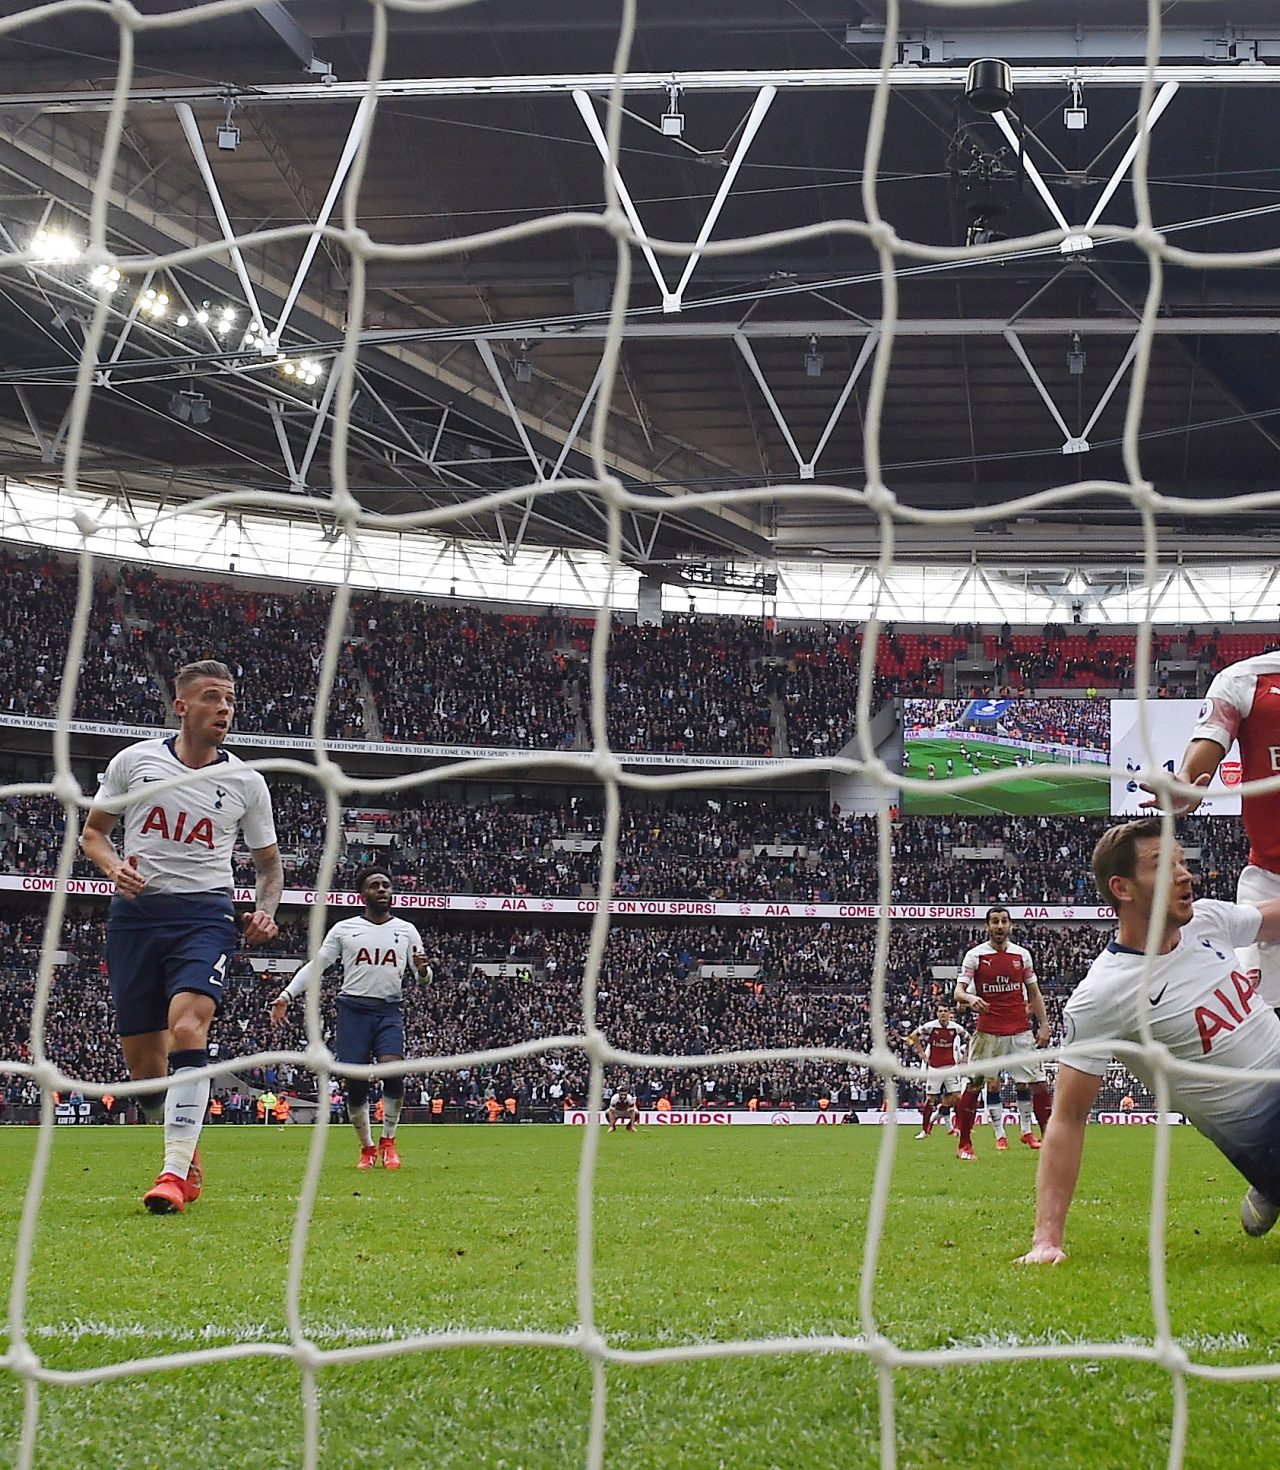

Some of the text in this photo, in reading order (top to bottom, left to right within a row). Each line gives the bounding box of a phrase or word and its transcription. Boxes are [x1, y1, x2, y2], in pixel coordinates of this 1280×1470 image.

[140, 806, 215, 850] AIA
[66, 879, 86, 893] ON
[400, 895, 451, 908] SPURS!
[501, 898, 528, 910] AIA
[618, 901, 637, 913] ON
[639, 902, 666, 913] YOU
[669, 903, 716, 914] SPURS!
[765, 904, 790, 916] AIA
[838, 906, 976, 917] COME YOU SPURS!
[1024, 907, 1049, 918] AIA
[355, 947, 398, 968] AIA
[213, 953, 227, 982] 4
[982, 982, 1021, 993] Emirates
[1194, 970, 1258, 1055] AIA
